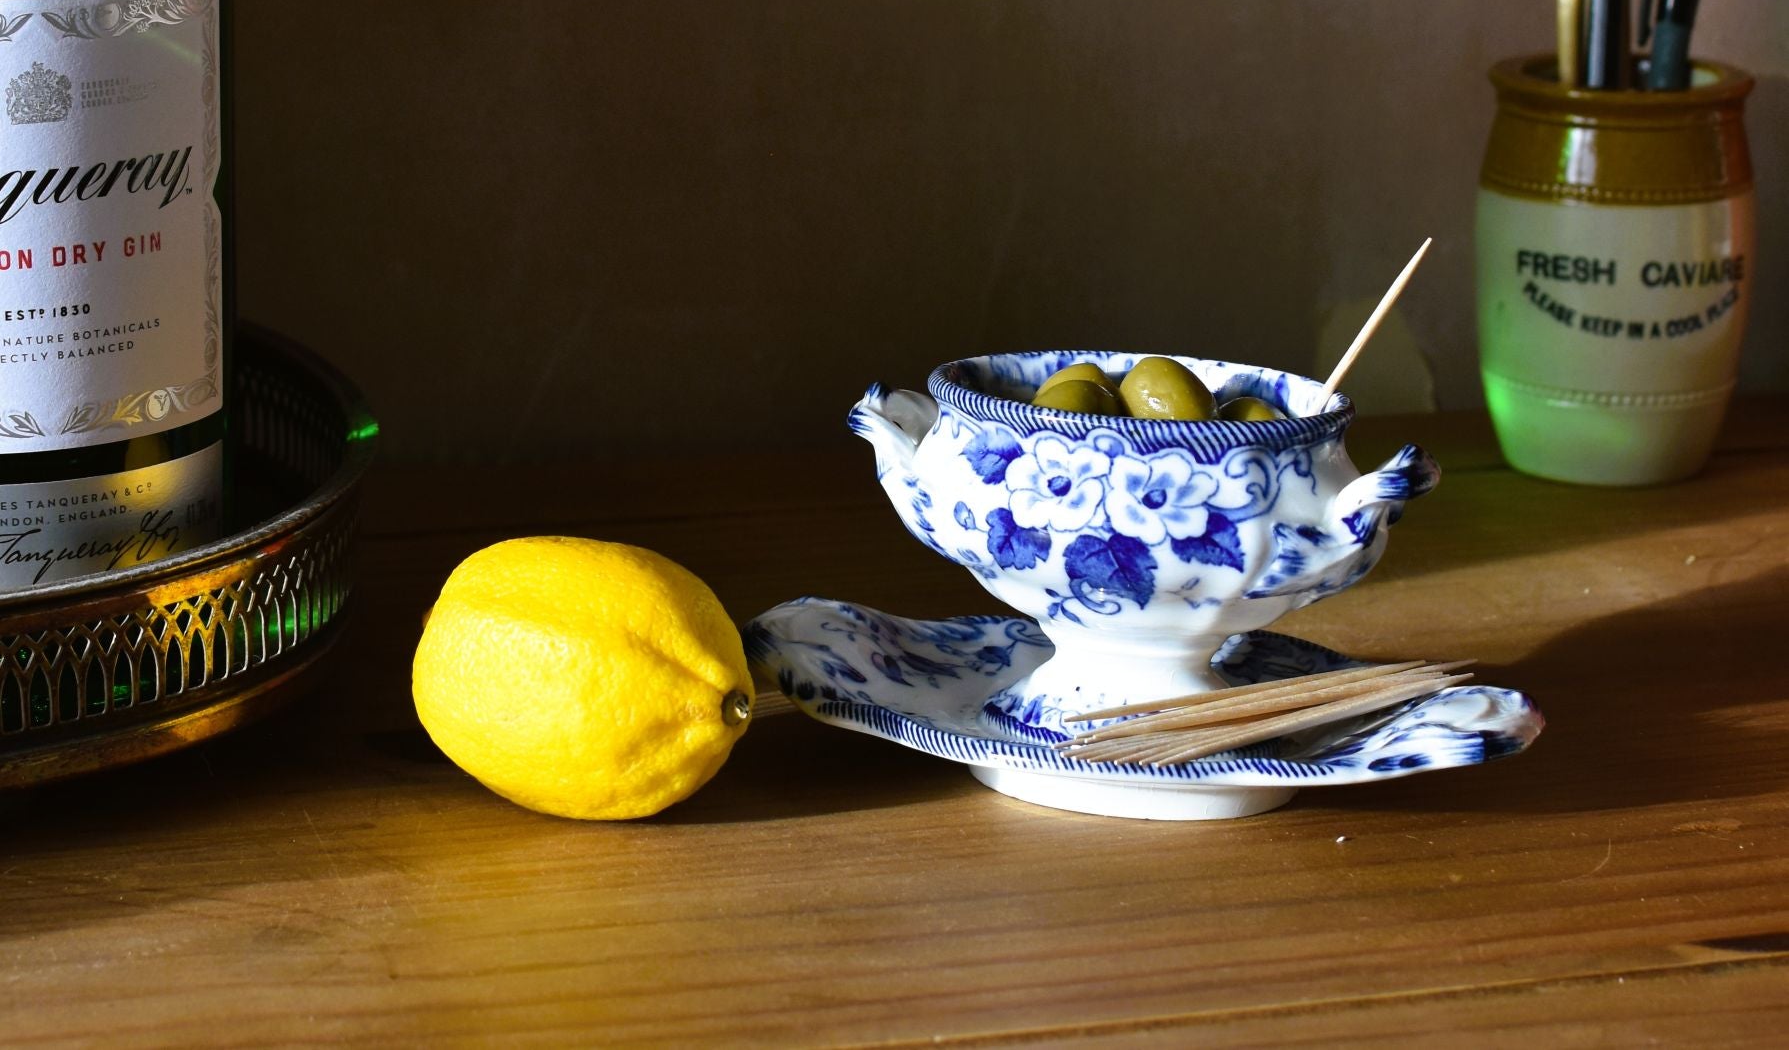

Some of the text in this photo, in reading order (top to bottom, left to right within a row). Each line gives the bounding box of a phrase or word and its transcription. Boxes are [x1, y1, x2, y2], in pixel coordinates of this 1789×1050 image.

[52, 241, 107, 267] DRY
[123, 232, 162, 258] GIN
[1516, 249, 1745, 288] FRESH CAVIARE
[52, 303, 91, 318] 1830
[1523, 280, 1575, 327] PLEASE
[1580, 314, 1624, 338] KEEP
[1626, 321, 1645, 340] IN
[1649, 321, 1662, 339] A
[1665, 313, 1704, 339] COOL
[3, 317, 161, 347] NATURE BOTANICALS
[0, 340, 135, 364] ECTLY BALANCED
[26, 489, 118, 510] TANQUERAY
[124, 487, 132, 497] &
